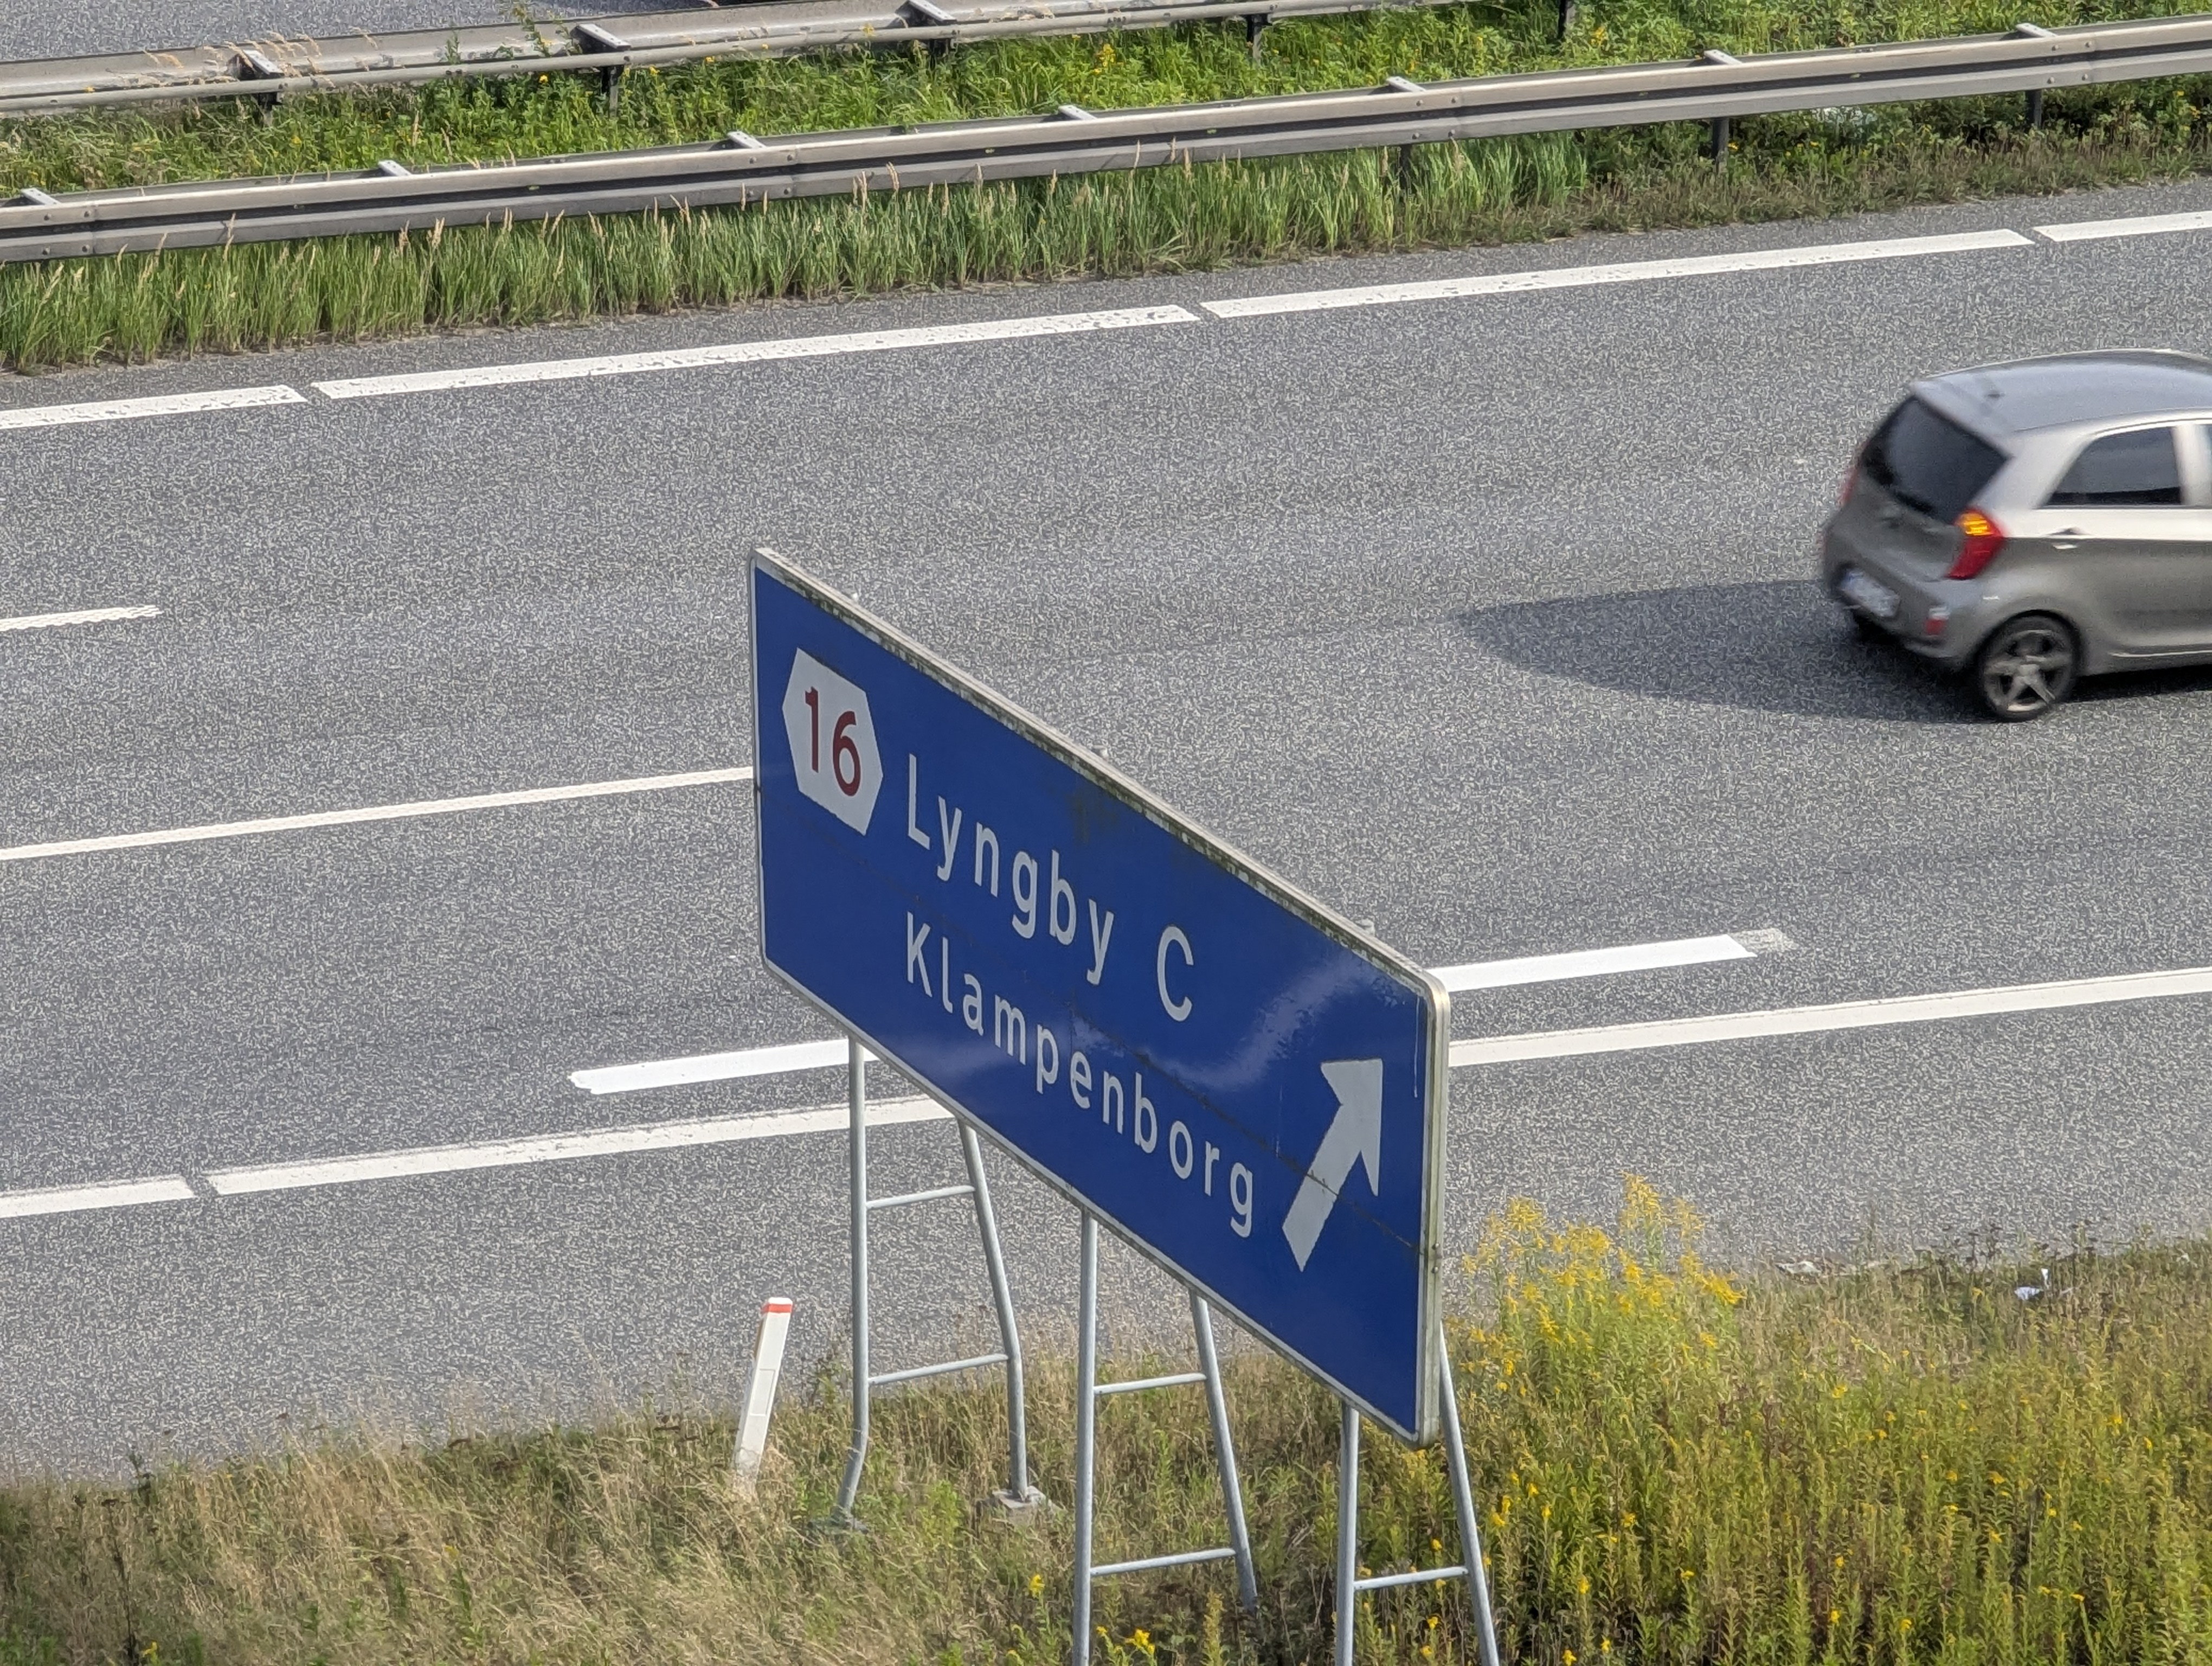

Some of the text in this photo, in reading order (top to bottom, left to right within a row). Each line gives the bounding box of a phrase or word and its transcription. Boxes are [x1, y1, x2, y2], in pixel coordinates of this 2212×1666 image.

[805, 688, 861, 797] 16
[908, 754, 1195, 1021] Lyngby C
[906, 912, 1253, 1238] Klampenborg
